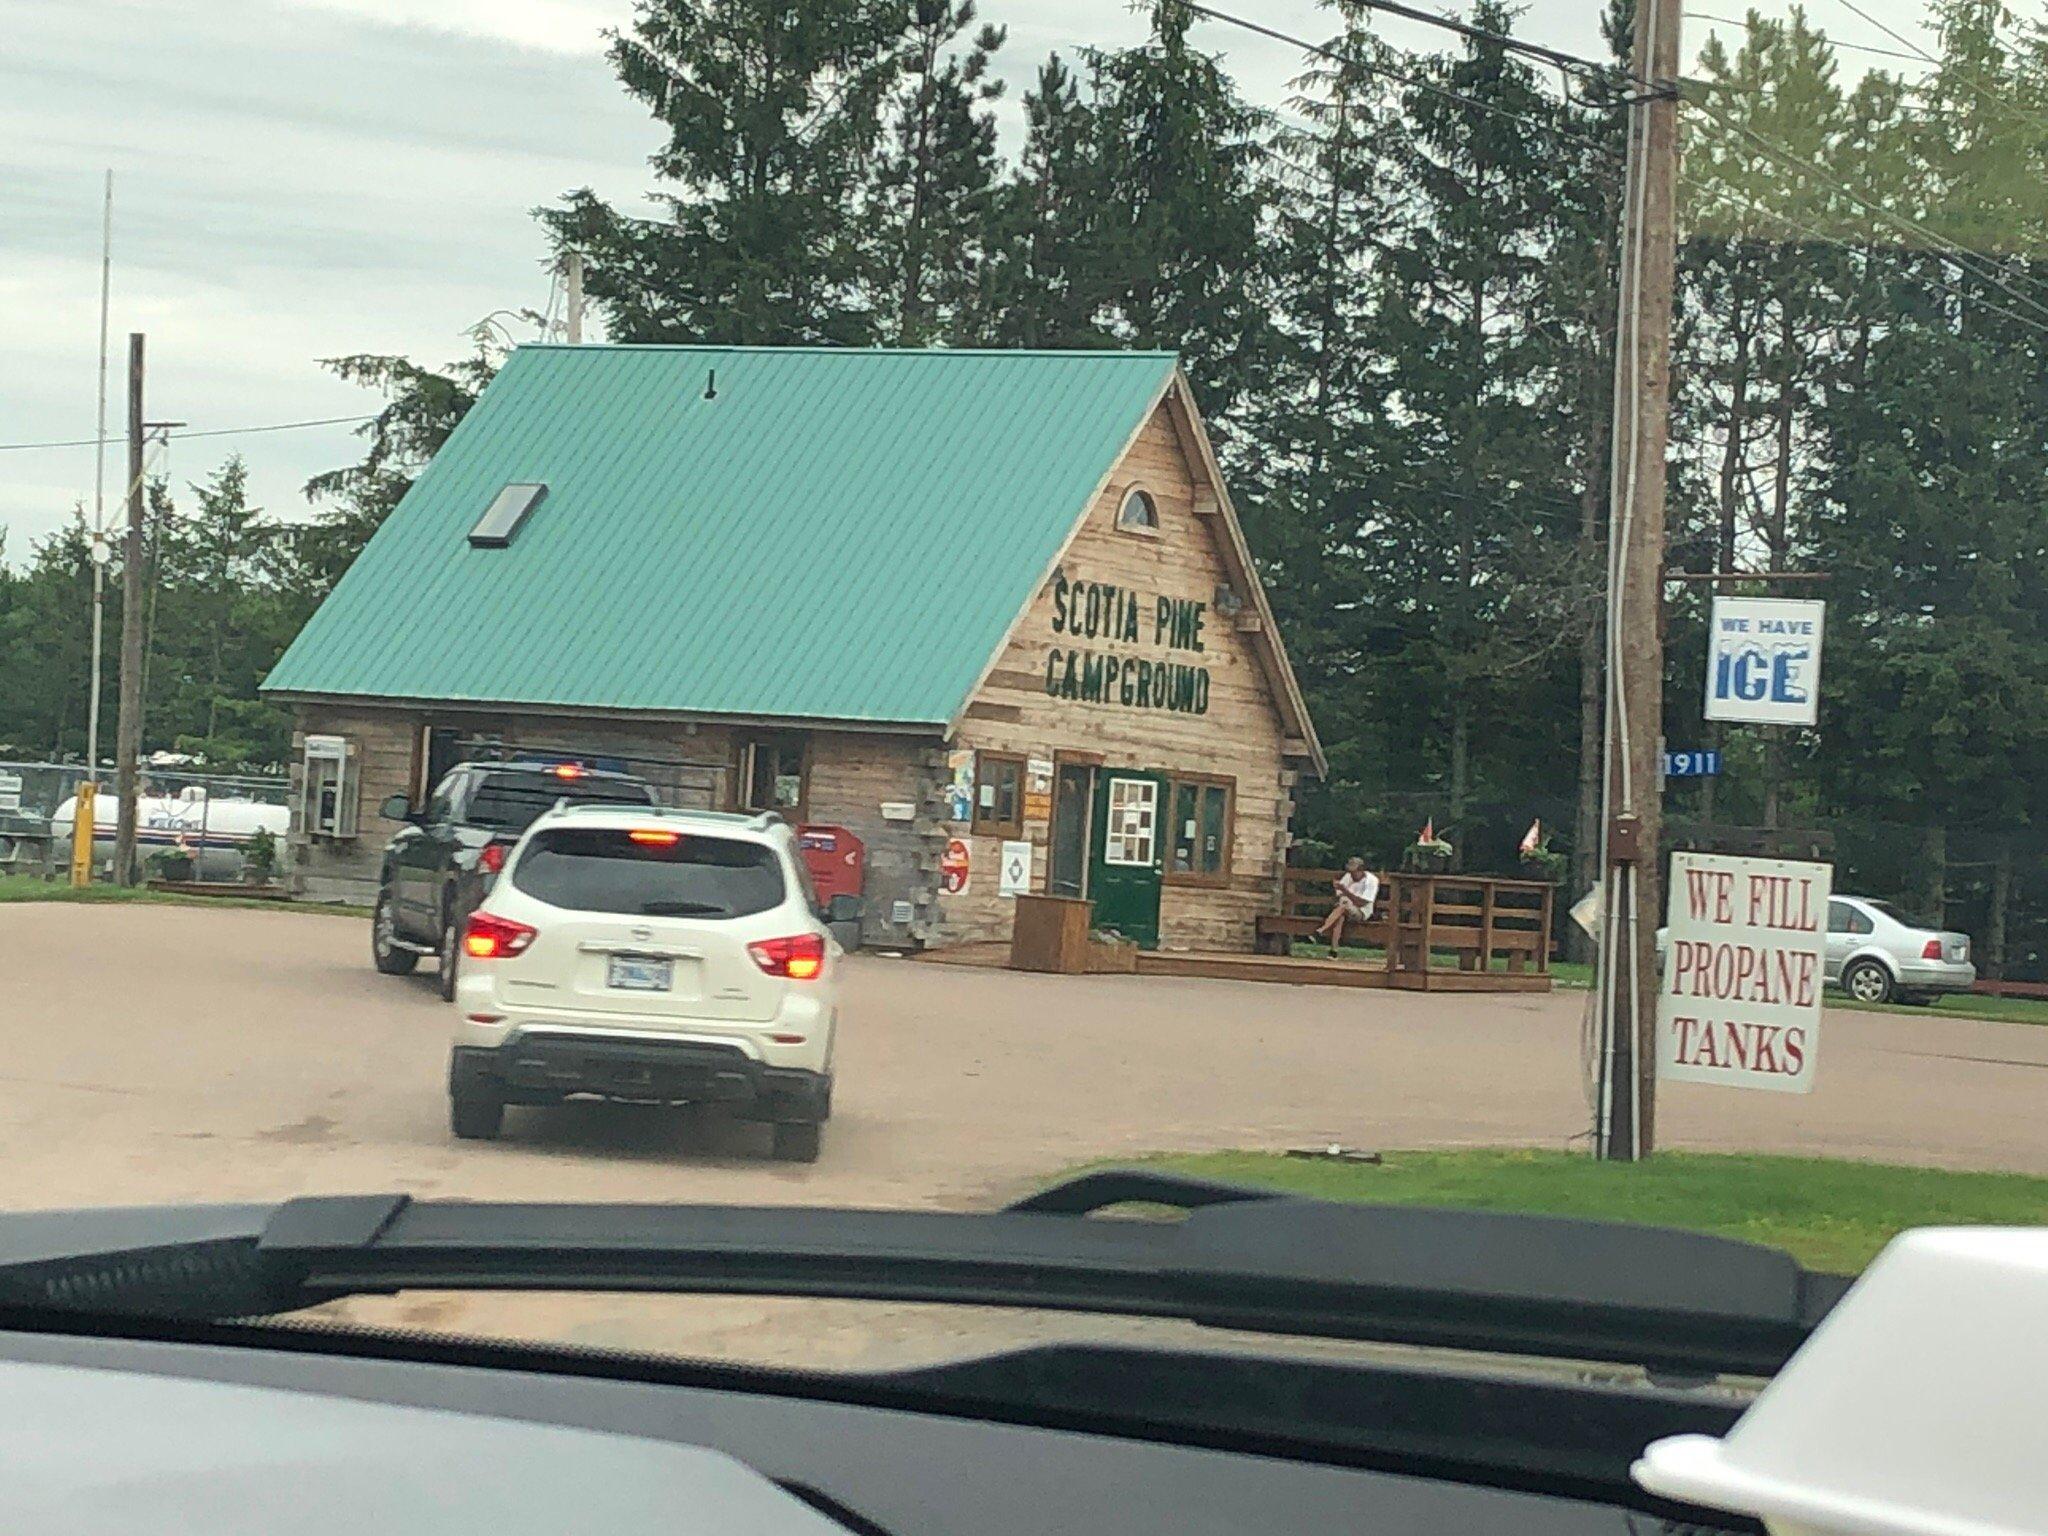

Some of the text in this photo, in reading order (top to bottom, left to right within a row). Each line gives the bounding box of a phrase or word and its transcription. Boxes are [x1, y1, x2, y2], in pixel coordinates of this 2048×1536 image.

[1052, 578, 1206, 652] SCOTIA PINE
[1721, 618, 1814, 635] WE HAVE
[1046, 649, 1210, 715] CAMPGROUND
[1715, 641, 1809, 703] ICE
[1663, 752, 1715, 775] 1911
[1686, 869, 1819, 932] WE FILL
[1671, 940, 1818, 1007] PROPANE
[1672, 1017, 1806, 1075] TANKS
